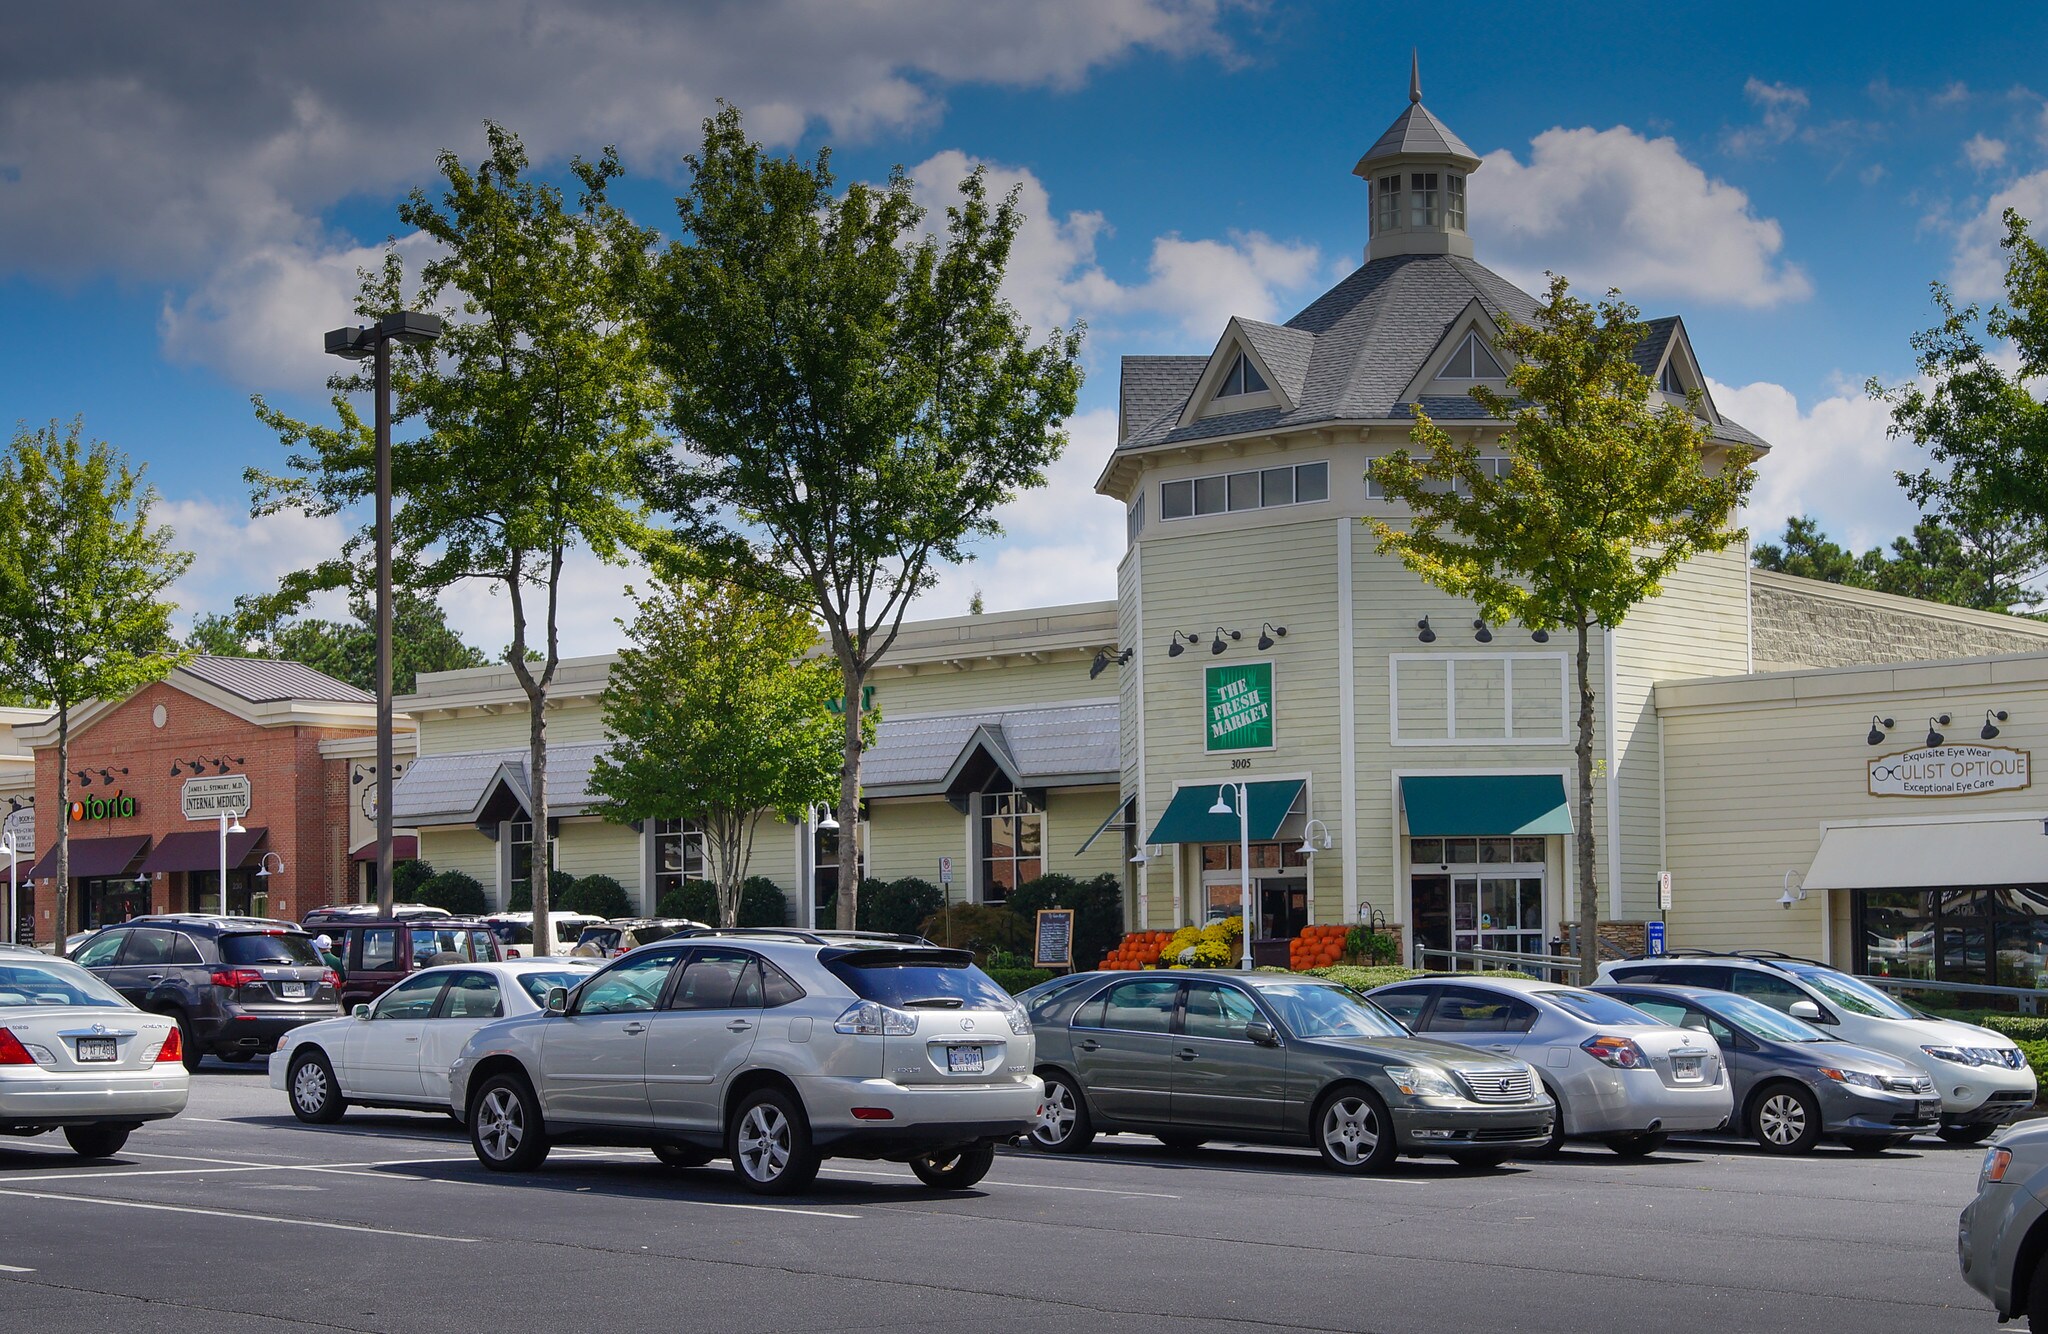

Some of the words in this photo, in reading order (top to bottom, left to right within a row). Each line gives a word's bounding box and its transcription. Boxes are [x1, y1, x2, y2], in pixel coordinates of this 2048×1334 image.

[1217, 677, 1248, 701] THE
[1212, 689, 1261, 721] FRESH
[1211, 702, 1268, 738] MARKET
[1903, 749, 1945, 763] Exquisite
[1947, 748, 1965, 758] Eye
[1966, 747, 1992, 757] Wear
[1230, 758, 1251, 769] 3005
[1950, 759, 2025, 778] OPTIQUE
[1903, 782, 1955, 794] Exceptional
[1956, 782, 1973, 793] Eye
[1973, 779, 1995, 790] Care
[186, 796, 215, 811] INTERNAL
[216, 794, 246, 809] MEDICINE
[1953, 905, 1976, 916] 300
[949, 1053, 959, 1065] CE
